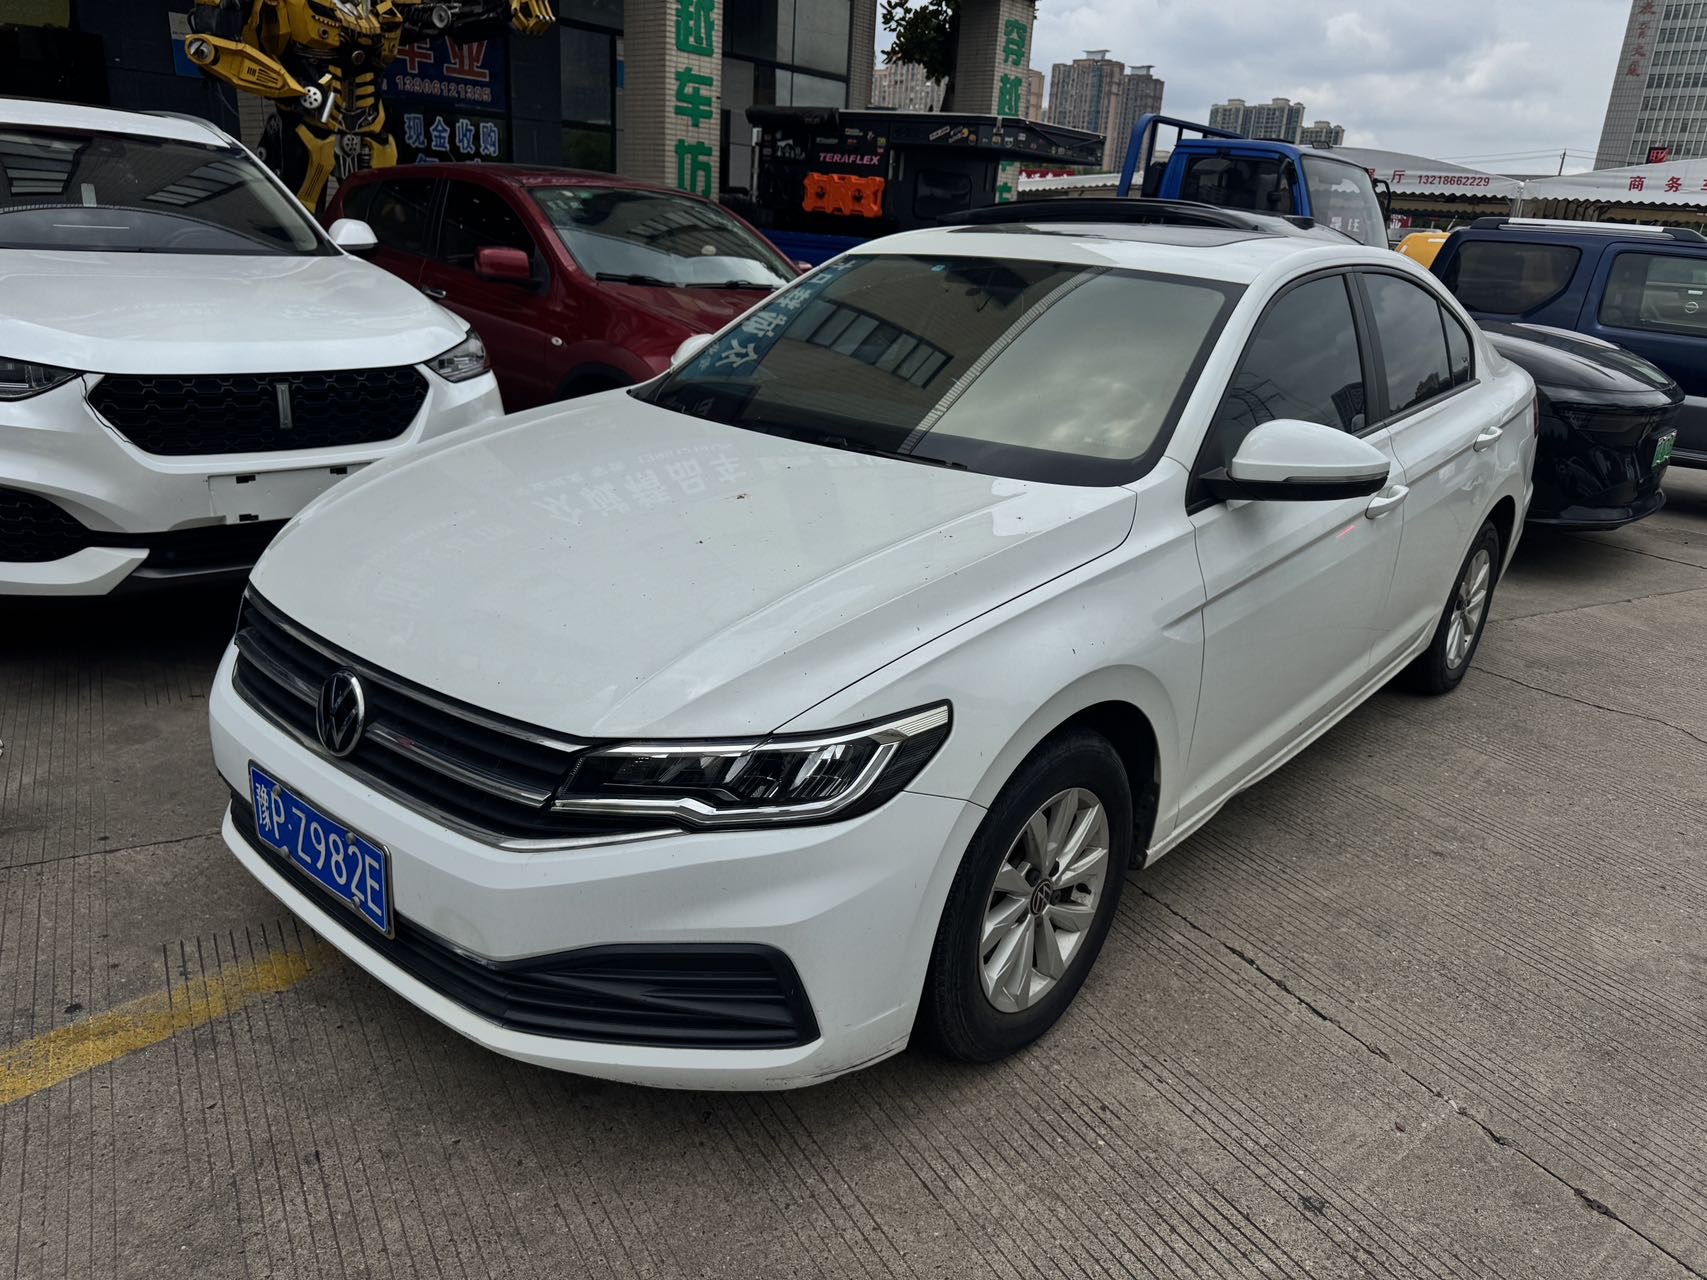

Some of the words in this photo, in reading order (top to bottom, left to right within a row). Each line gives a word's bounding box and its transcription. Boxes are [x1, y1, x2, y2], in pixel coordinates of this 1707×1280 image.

[996, 18, 1028, 203] 穿越
[404, 113, 500, 157] 现金收购
[819, 152, 881, 165] TERAFLEX
[1417, 175, 1490, 188] 13218662229
